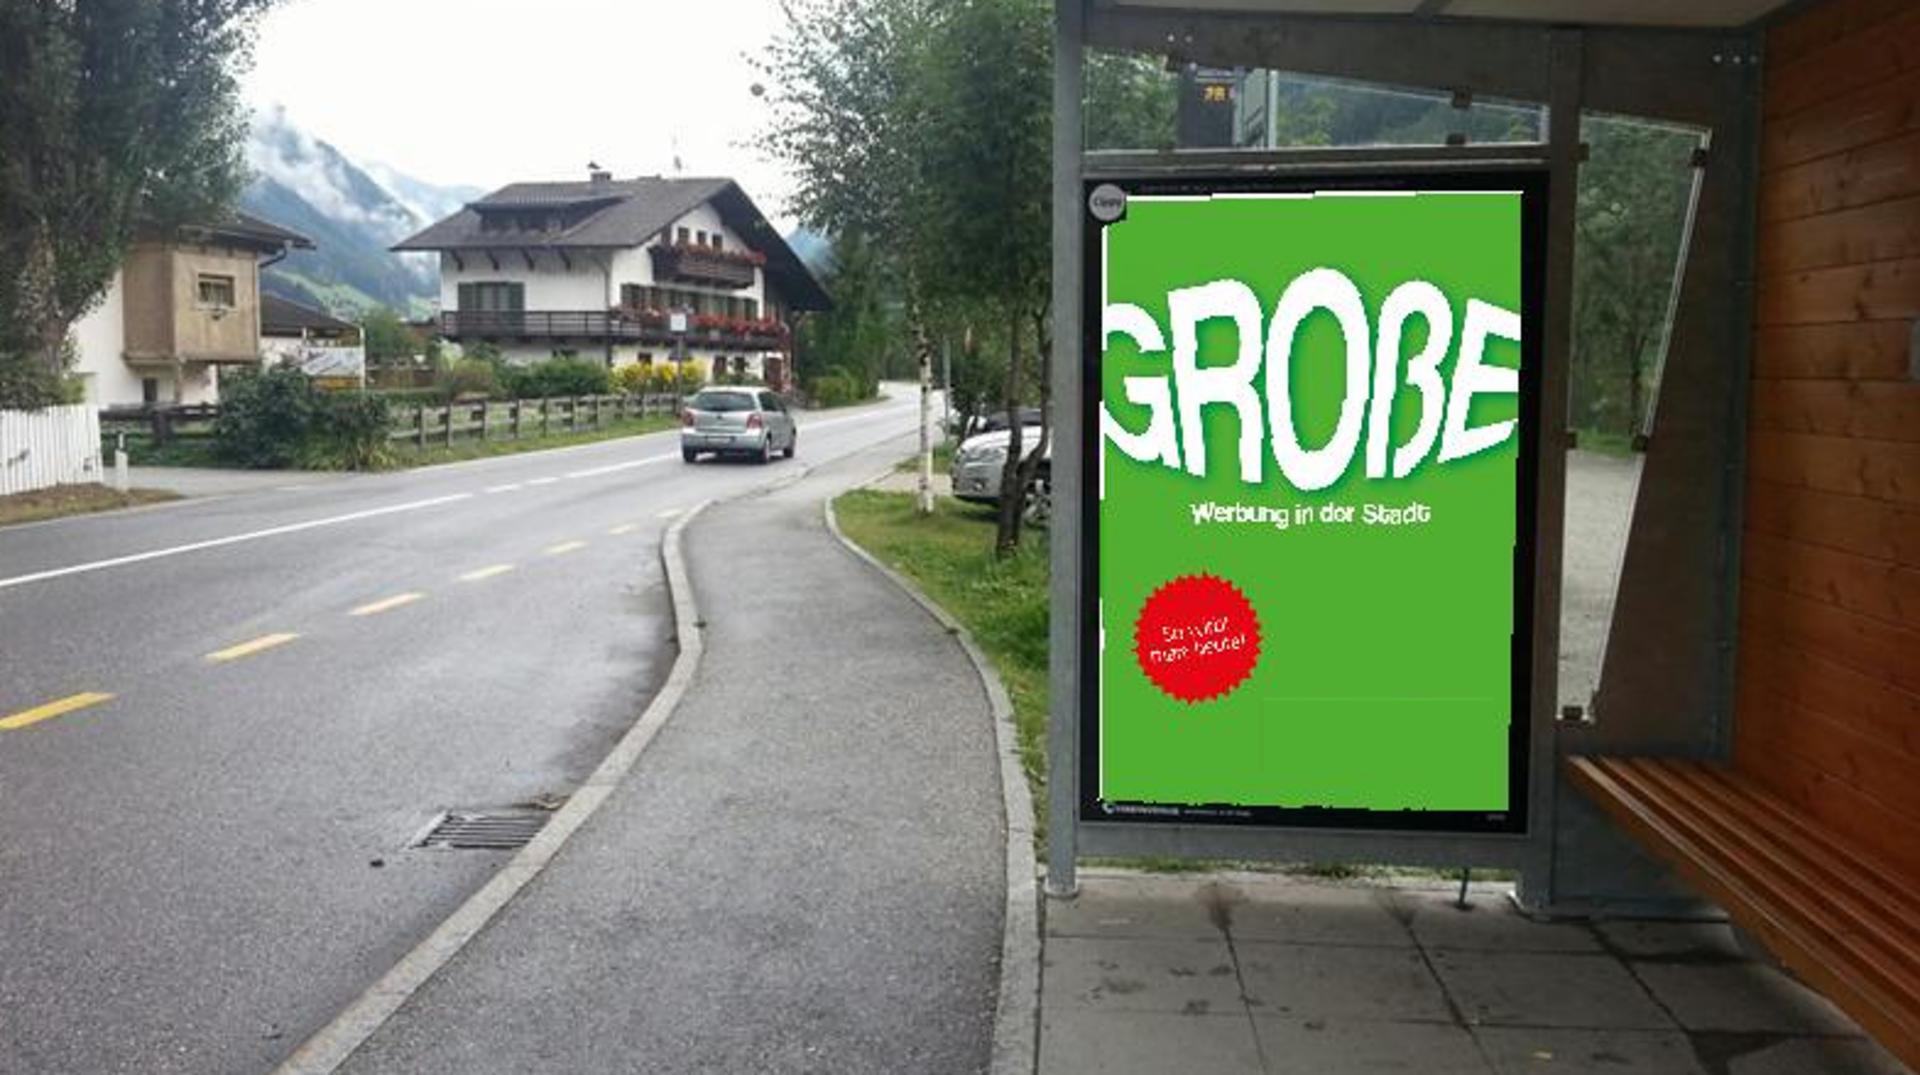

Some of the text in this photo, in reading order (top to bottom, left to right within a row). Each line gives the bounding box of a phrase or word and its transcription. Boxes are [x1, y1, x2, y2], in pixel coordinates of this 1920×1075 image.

[1190, 501, 1431, 530] Werbung in der Stadt
